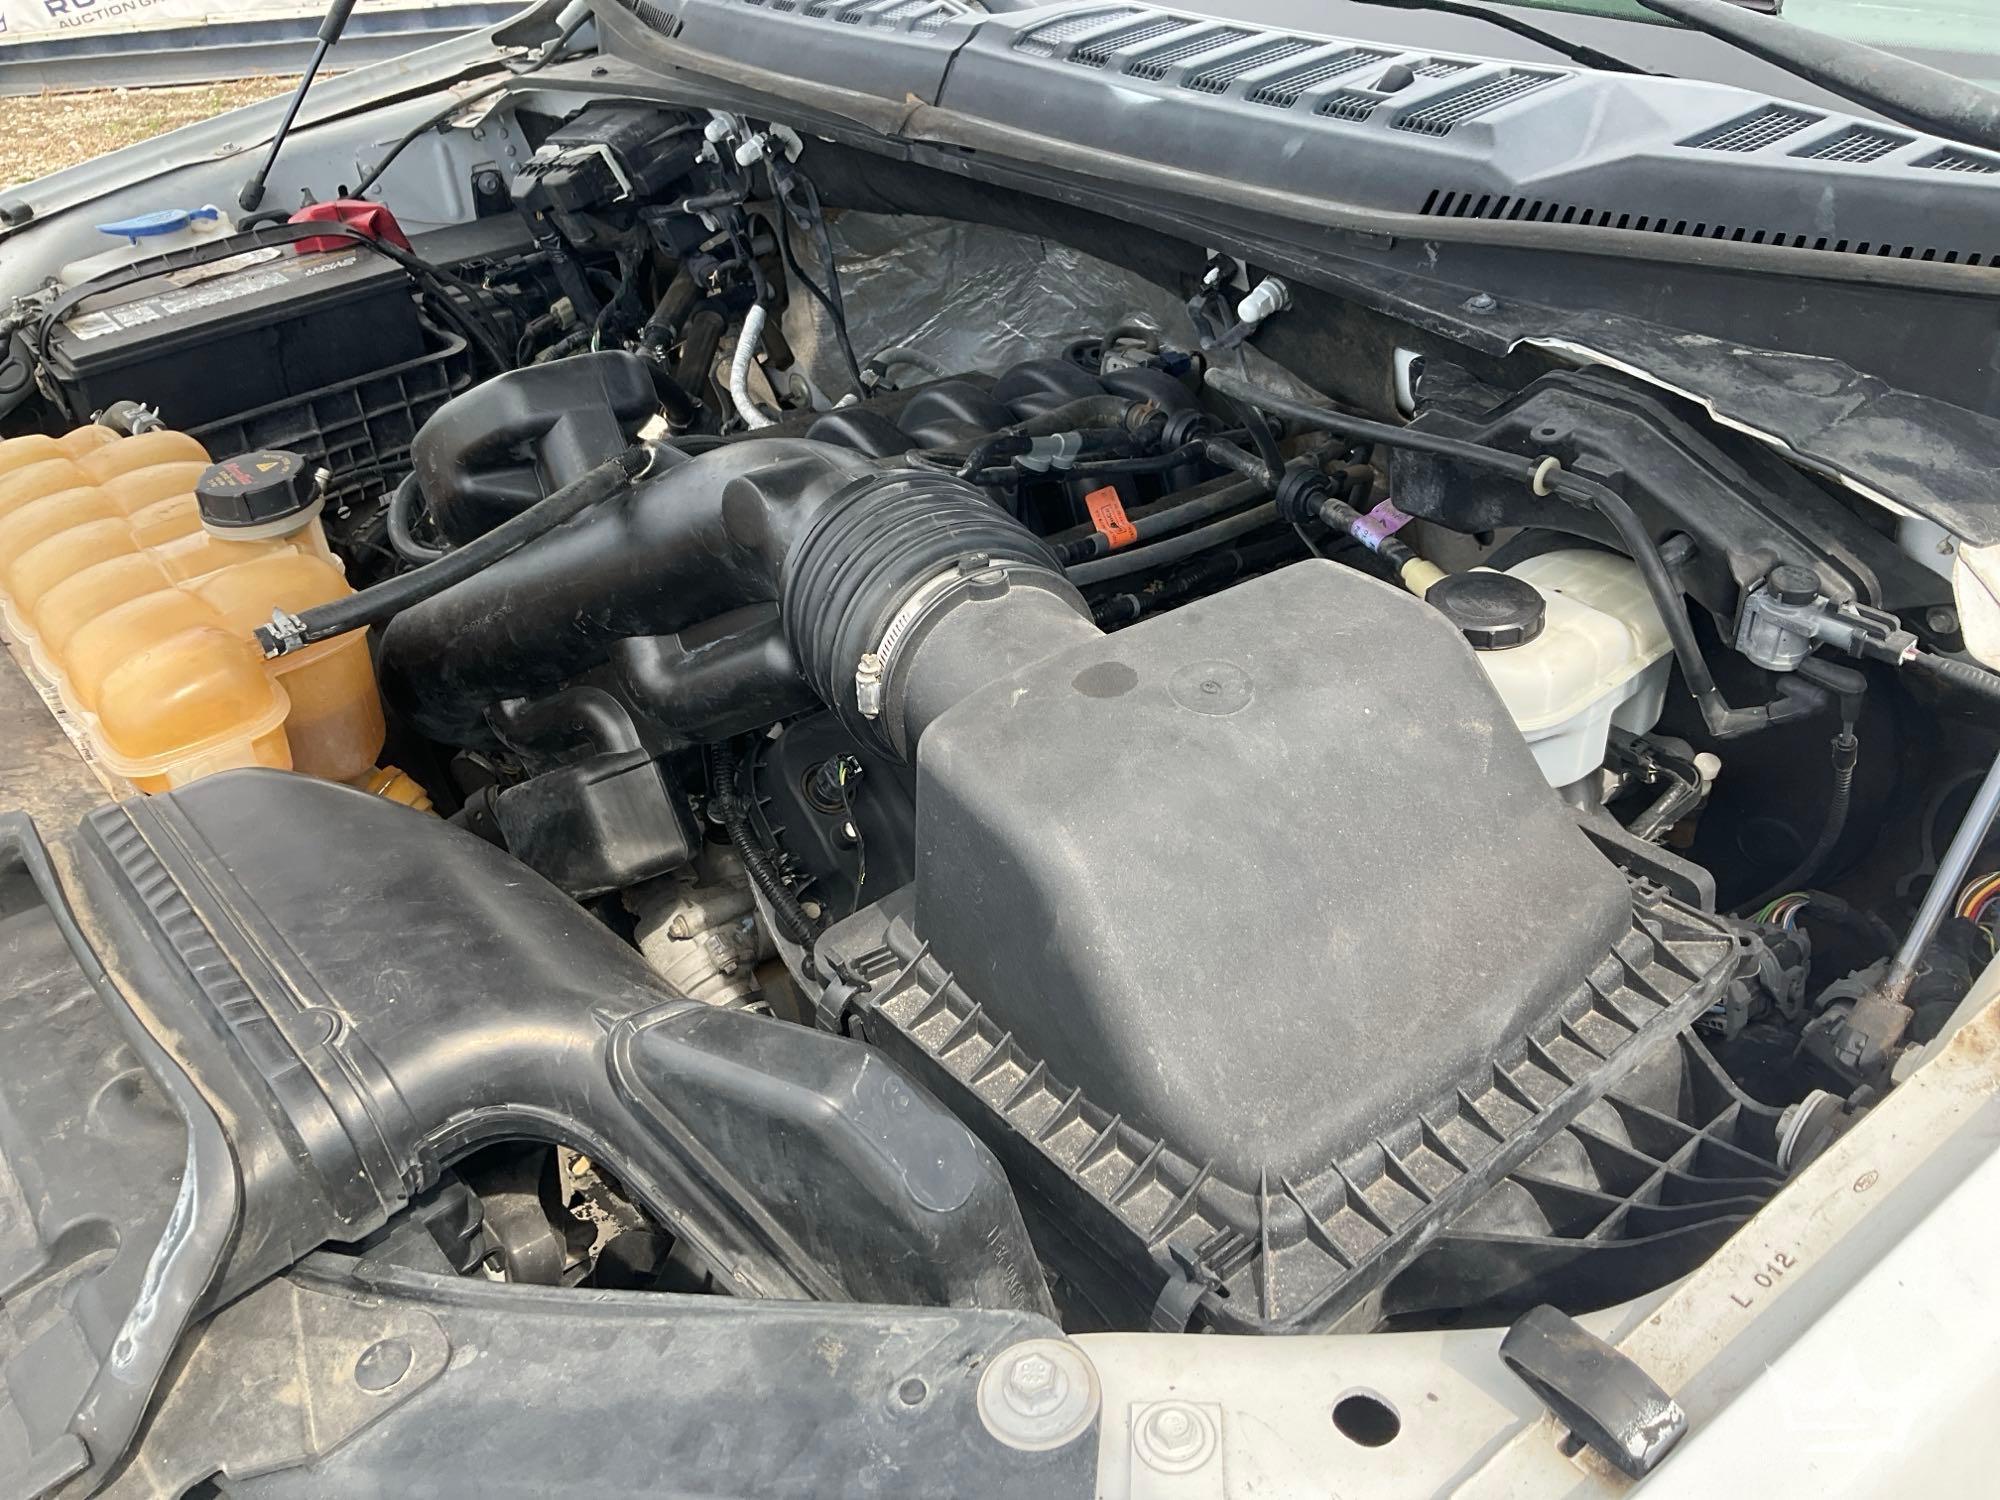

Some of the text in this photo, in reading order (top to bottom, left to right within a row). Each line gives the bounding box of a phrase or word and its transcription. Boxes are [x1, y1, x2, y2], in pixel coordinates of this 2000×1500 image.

[58, 1, 136, 29] AUCTION
[1730, 1253, 1797, 1309] L 012
